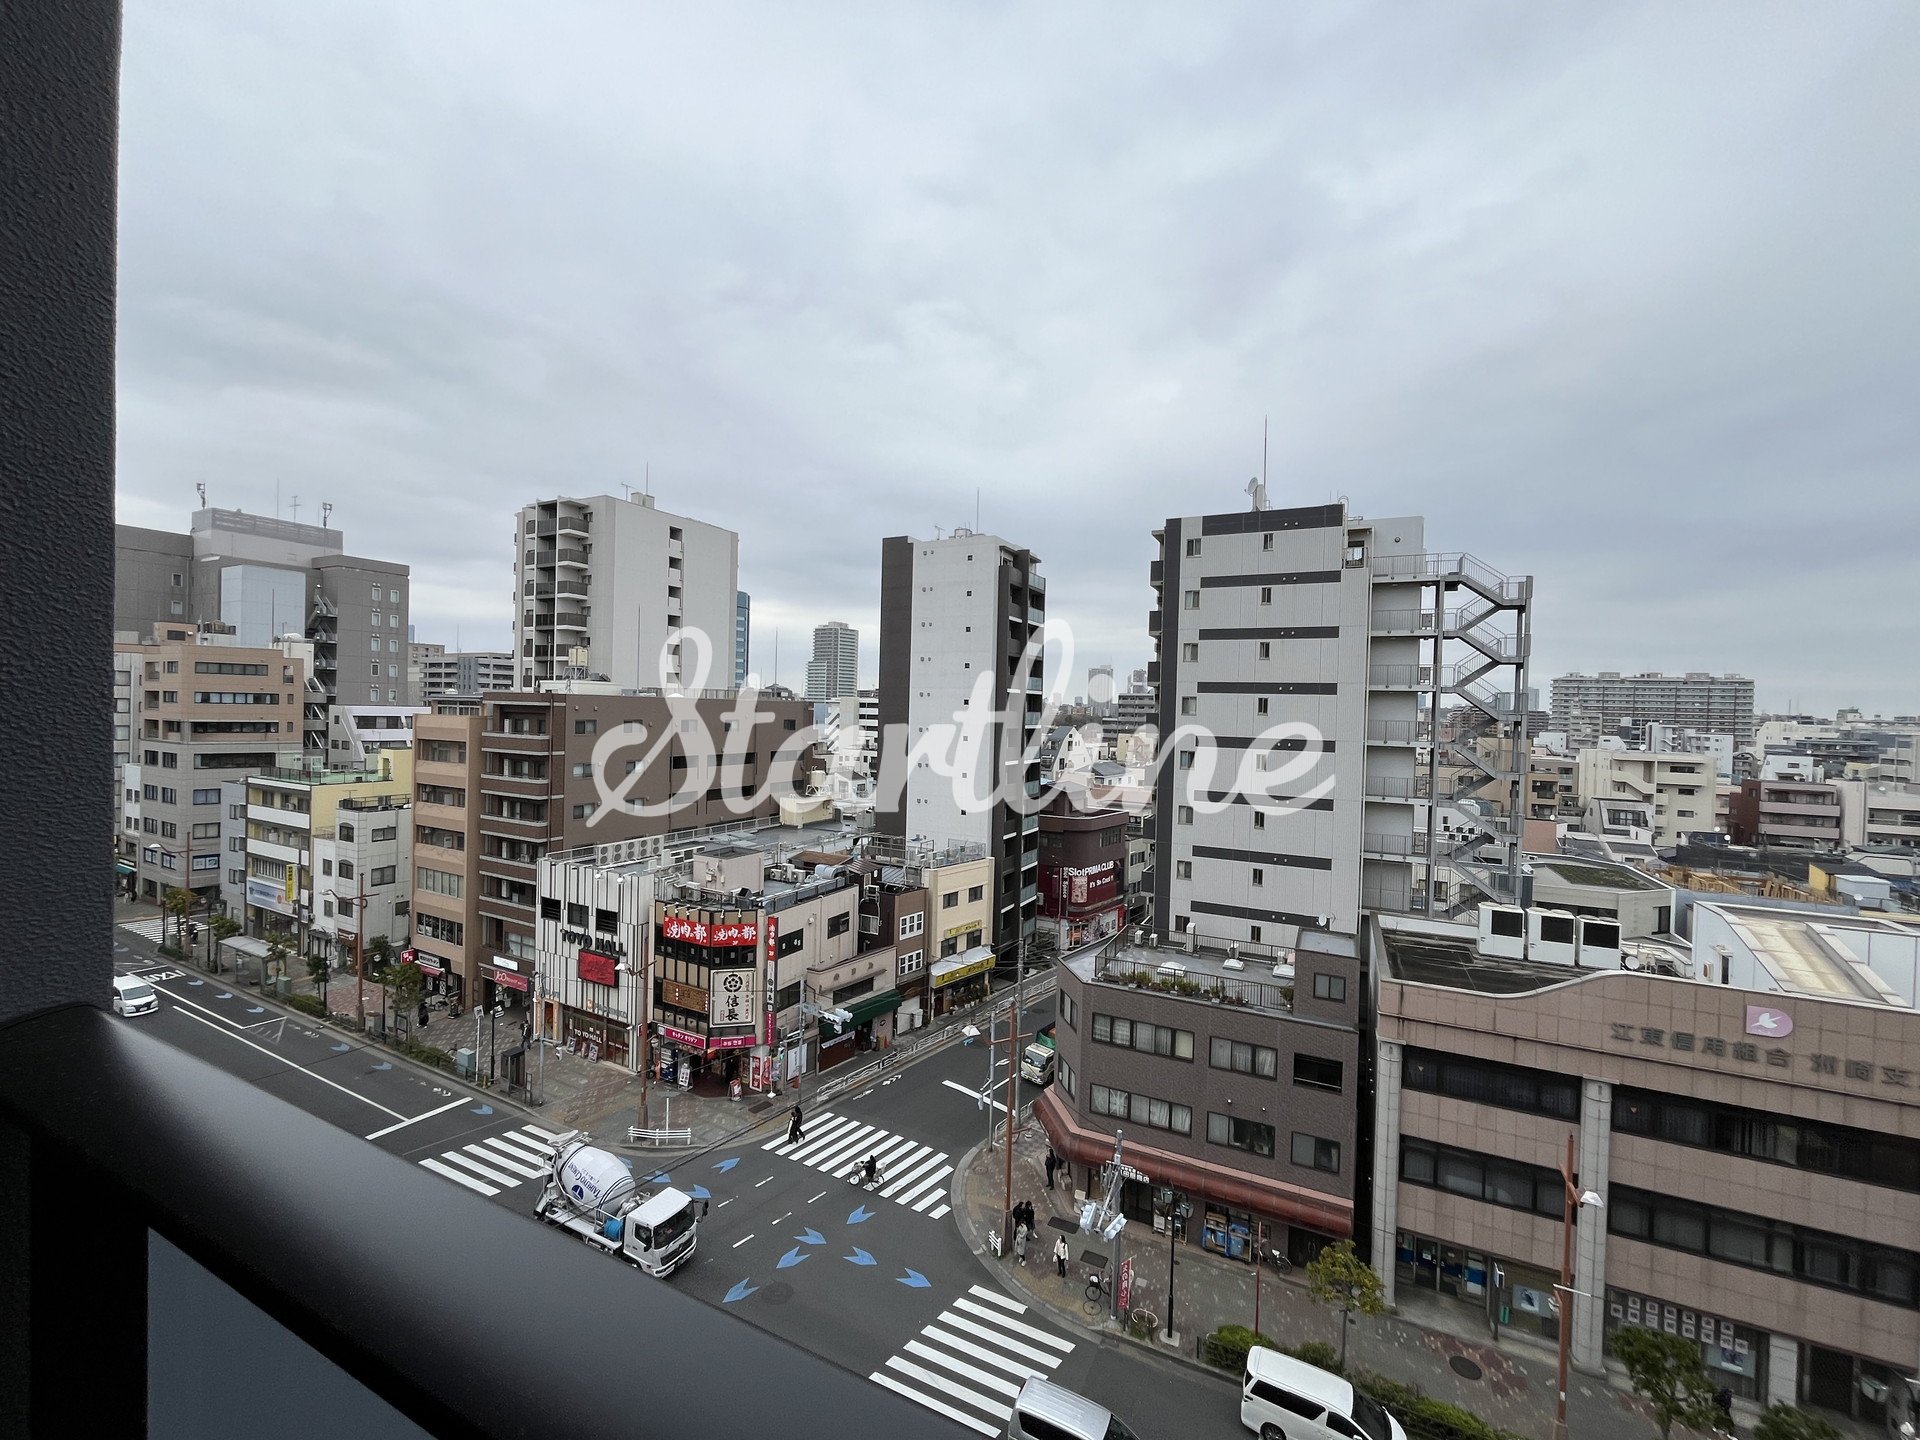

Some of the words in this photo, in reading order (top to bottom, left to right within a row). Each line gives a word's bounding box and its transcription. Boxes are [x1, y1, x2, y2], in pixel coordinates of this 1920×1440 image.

[1068, 867, 1084, 876] Slot
[1101, 860, 1114, 871] CLUB
[560, 928, 592, 949] TOYO
[595, 937, 627, 957] HALL
[667, 921, 707, 943] 焼肉の都
[714, 925, 757, 941] 焼肉の都
[725, 994, 739, 1021] 信長
[1610, 1022, 1792, 1068] 江東信用組合
[1810, 1053, 1920, 1087] 洲崎支
